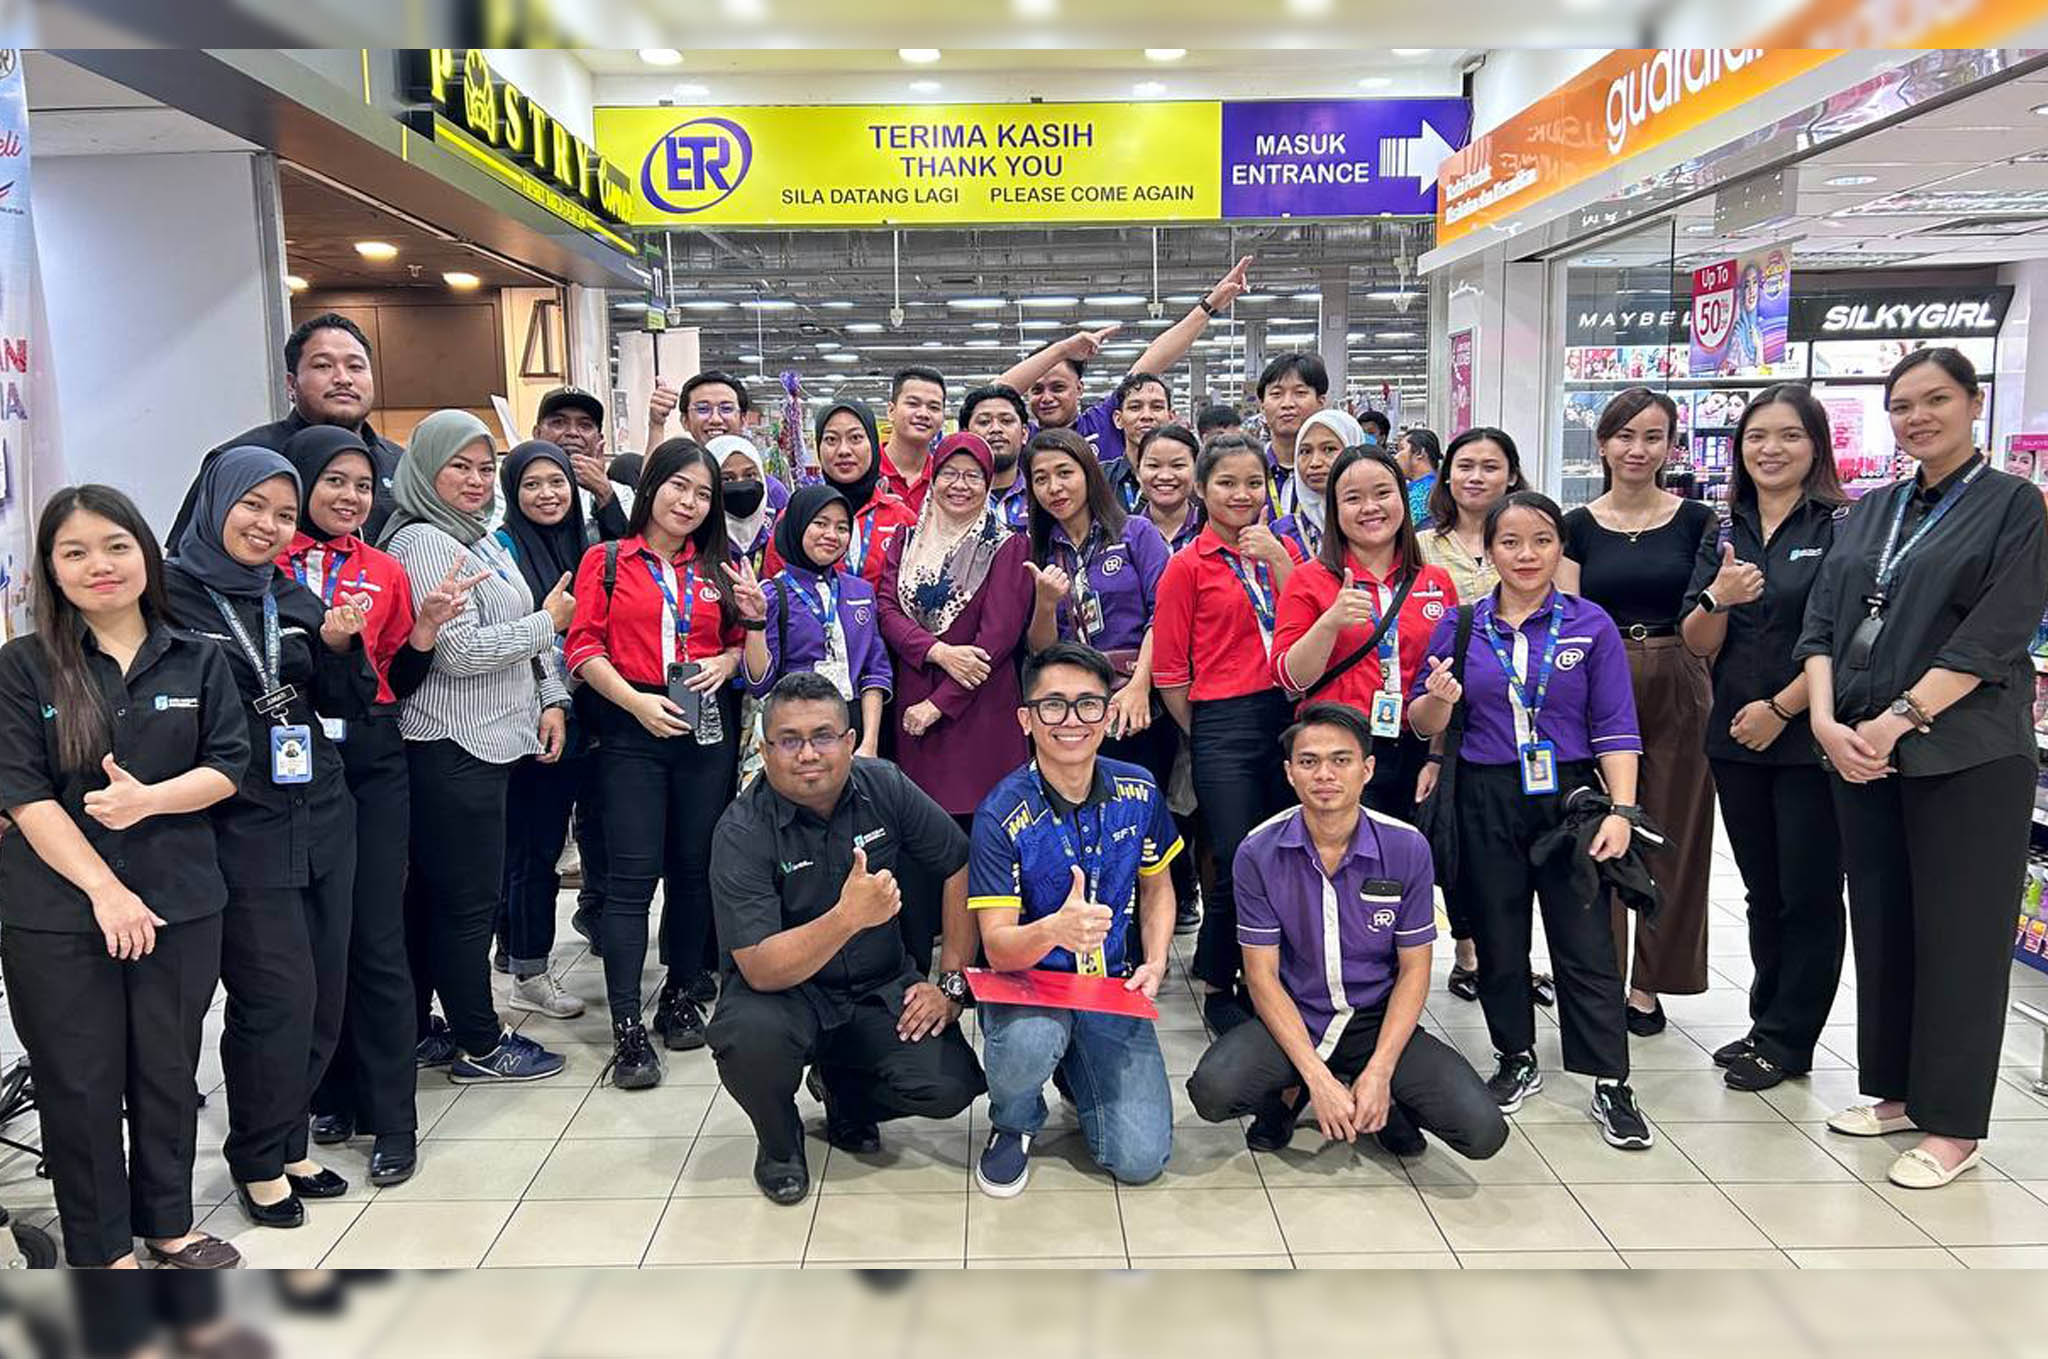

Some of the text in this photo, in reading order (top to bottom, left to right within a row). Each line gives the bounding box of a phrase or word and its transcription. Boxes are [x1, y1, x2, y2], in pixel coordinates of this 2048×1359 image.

[868, 122, 1094, 149] TERIMA KASIH
[1255, 133, 1346, 156] MASUK
[665, 136, 731, 191] ETR
[901, 154, 1063, 178] THANK YOU
[1232, 162, 1370, 185] ENTRANCE
[781, 187, 959, 205] SILA DATANG LAGI
[990, 184, 1195, 203] PLEASE COME AGAIN
[1701, 264, 1729, 291] Up To
[1700, 300, 1720, 336] 50
[1821, 302, 1997, 331] SILKYGIRL
